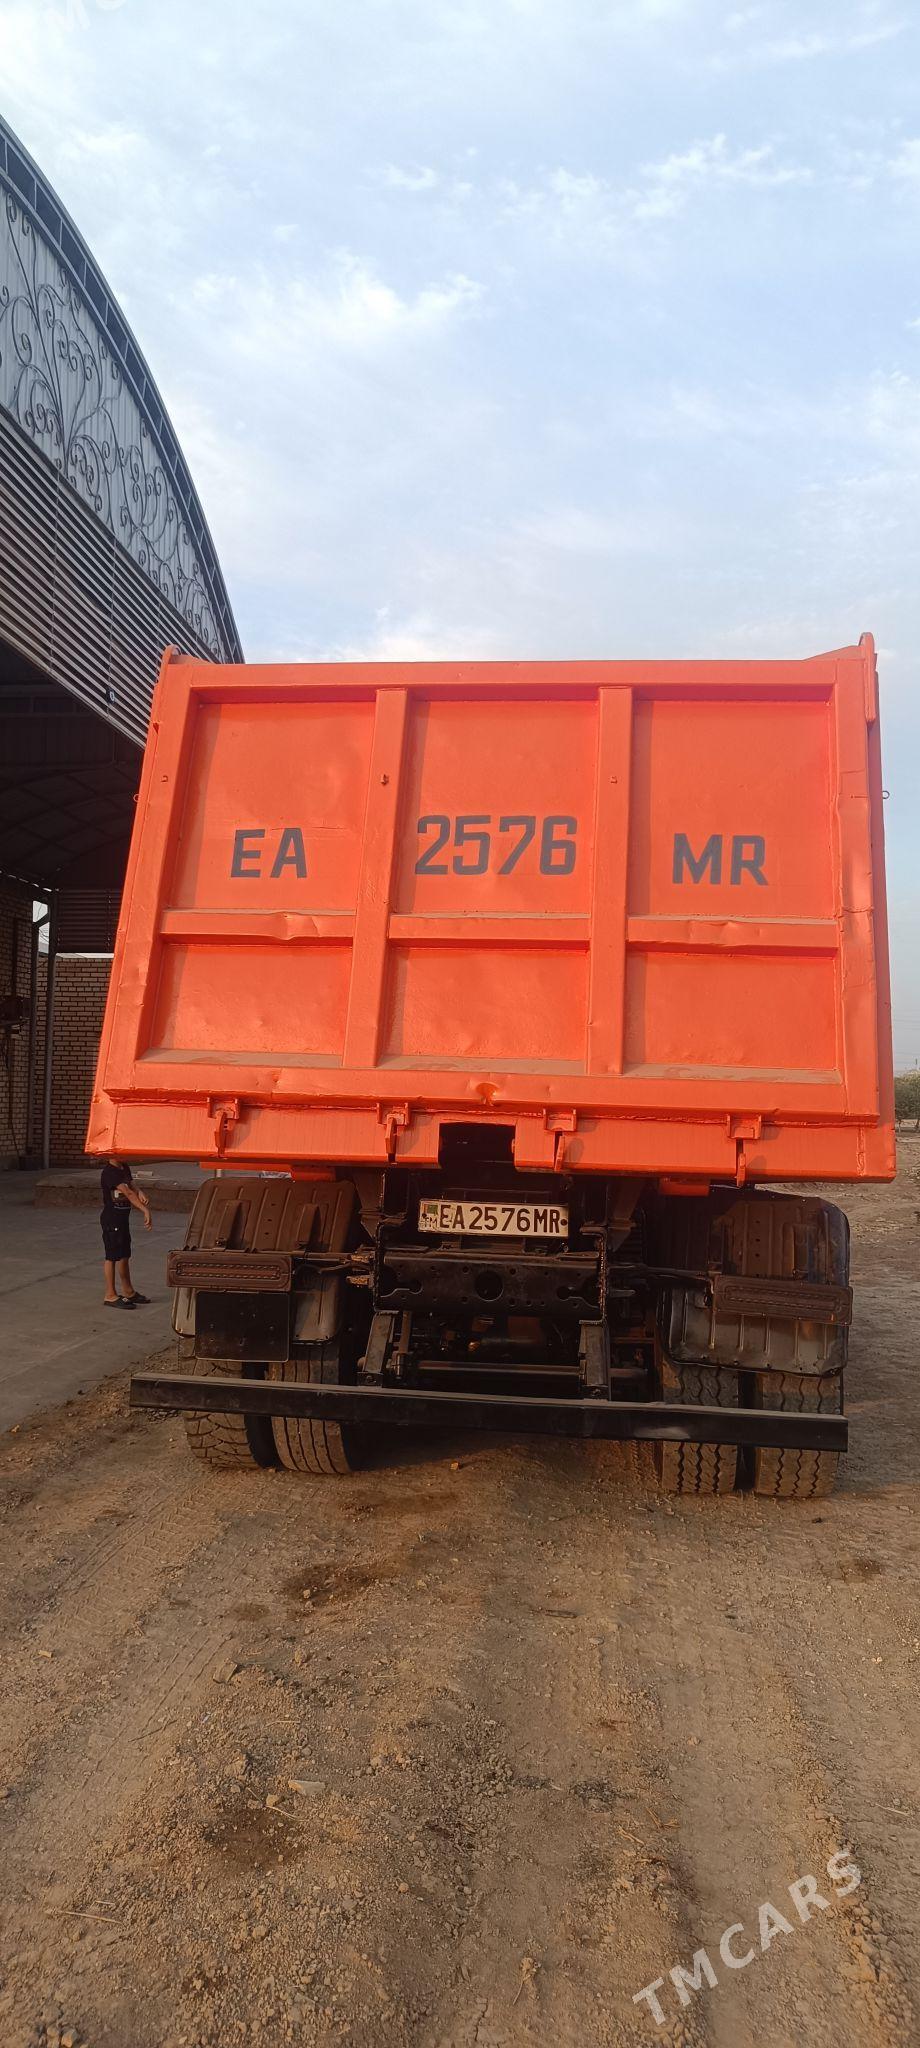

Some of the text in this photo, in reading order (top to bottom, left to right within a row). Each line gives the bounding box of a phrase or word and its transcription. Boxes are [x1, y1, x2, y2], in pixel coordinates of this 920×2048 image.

[231, 815, 768, 886] EA 2576 MR
